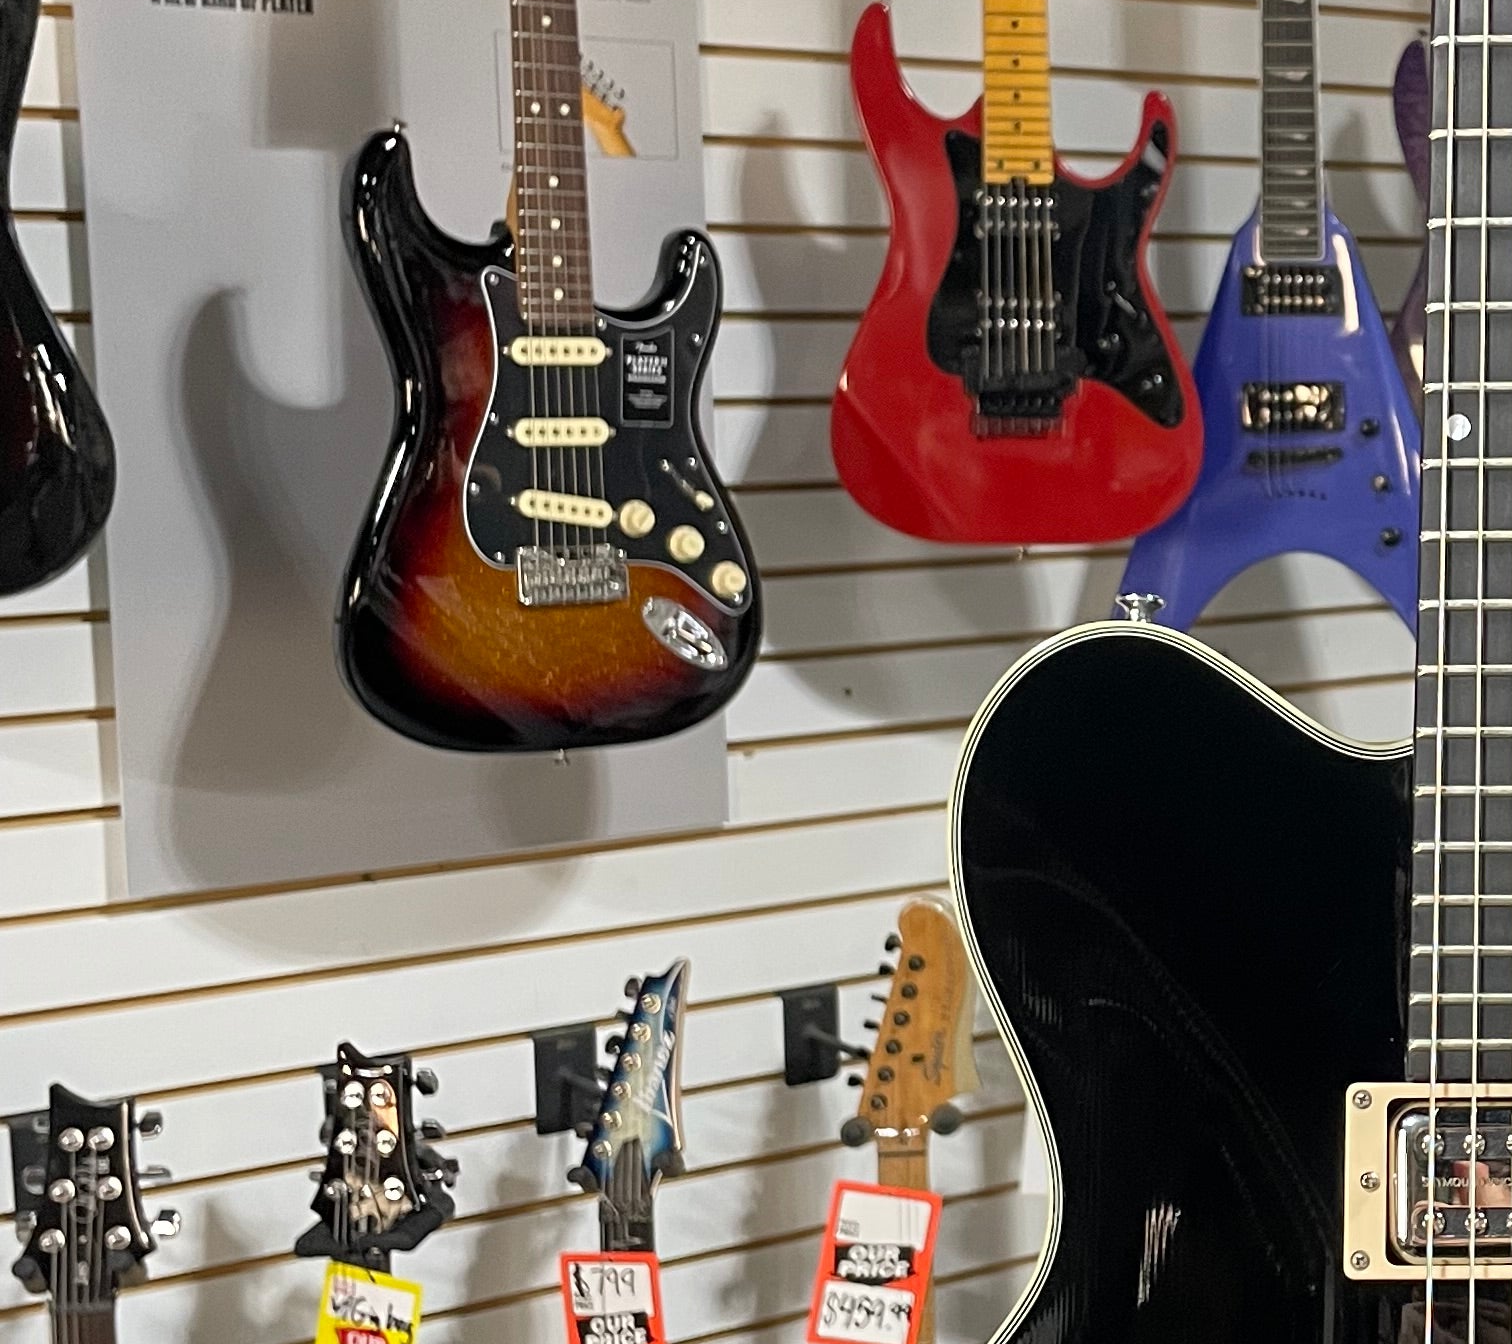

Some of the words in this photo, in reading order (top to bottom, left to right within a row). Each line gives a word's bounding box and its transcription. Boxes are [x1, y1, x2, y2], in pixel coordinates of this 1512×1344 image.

[849, 1244, 901, 1262] OUR
[837, 1259, 911, 1279] PRICE
[590, 1313, 636, 1335] OUR
